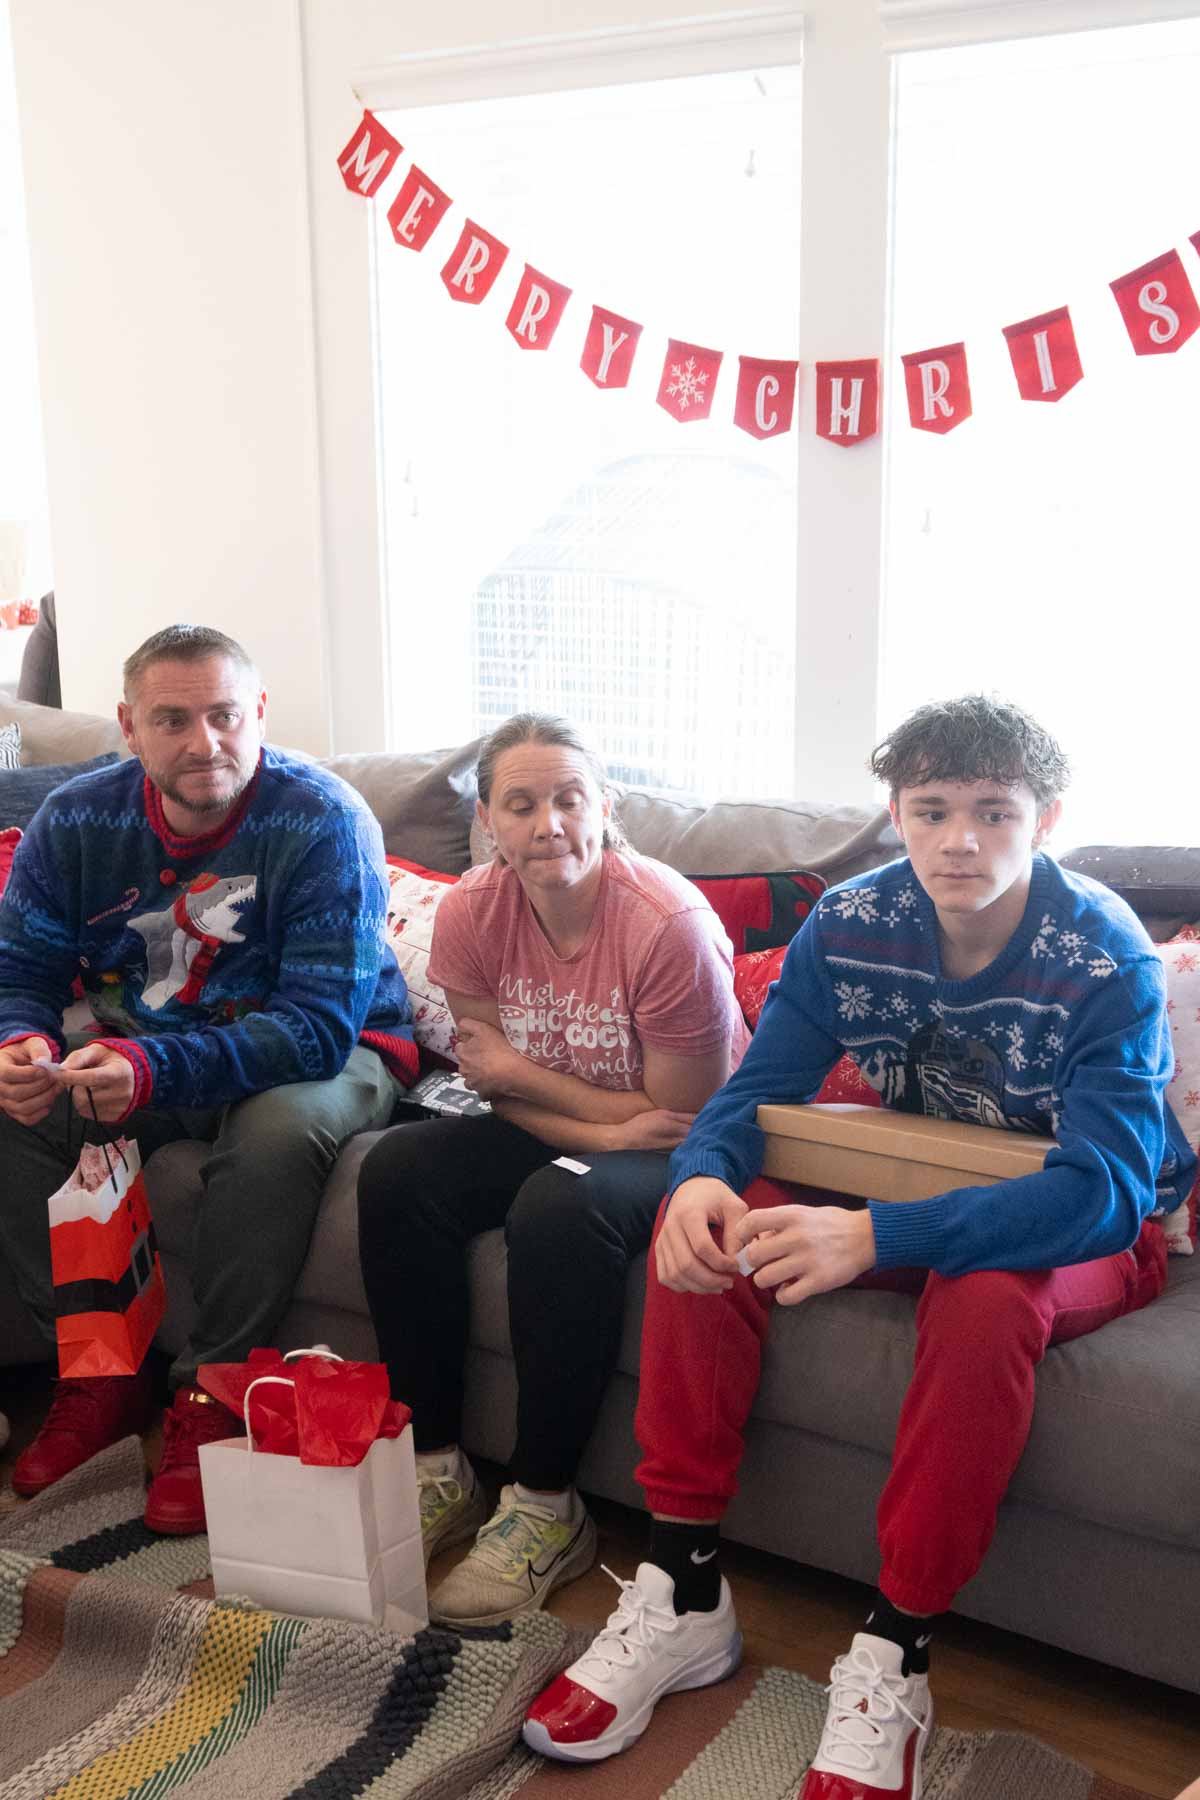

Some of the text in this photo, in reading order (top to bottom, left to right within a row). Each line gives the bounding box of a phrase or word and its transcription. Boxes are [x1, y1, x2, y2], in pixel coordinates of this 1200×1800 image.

[341, 130, 1180, 437] MERRY CHRIS
[498, 973, 599, 1022] Mistetoe
[527, 1007, 630, 1049] HO COCO
